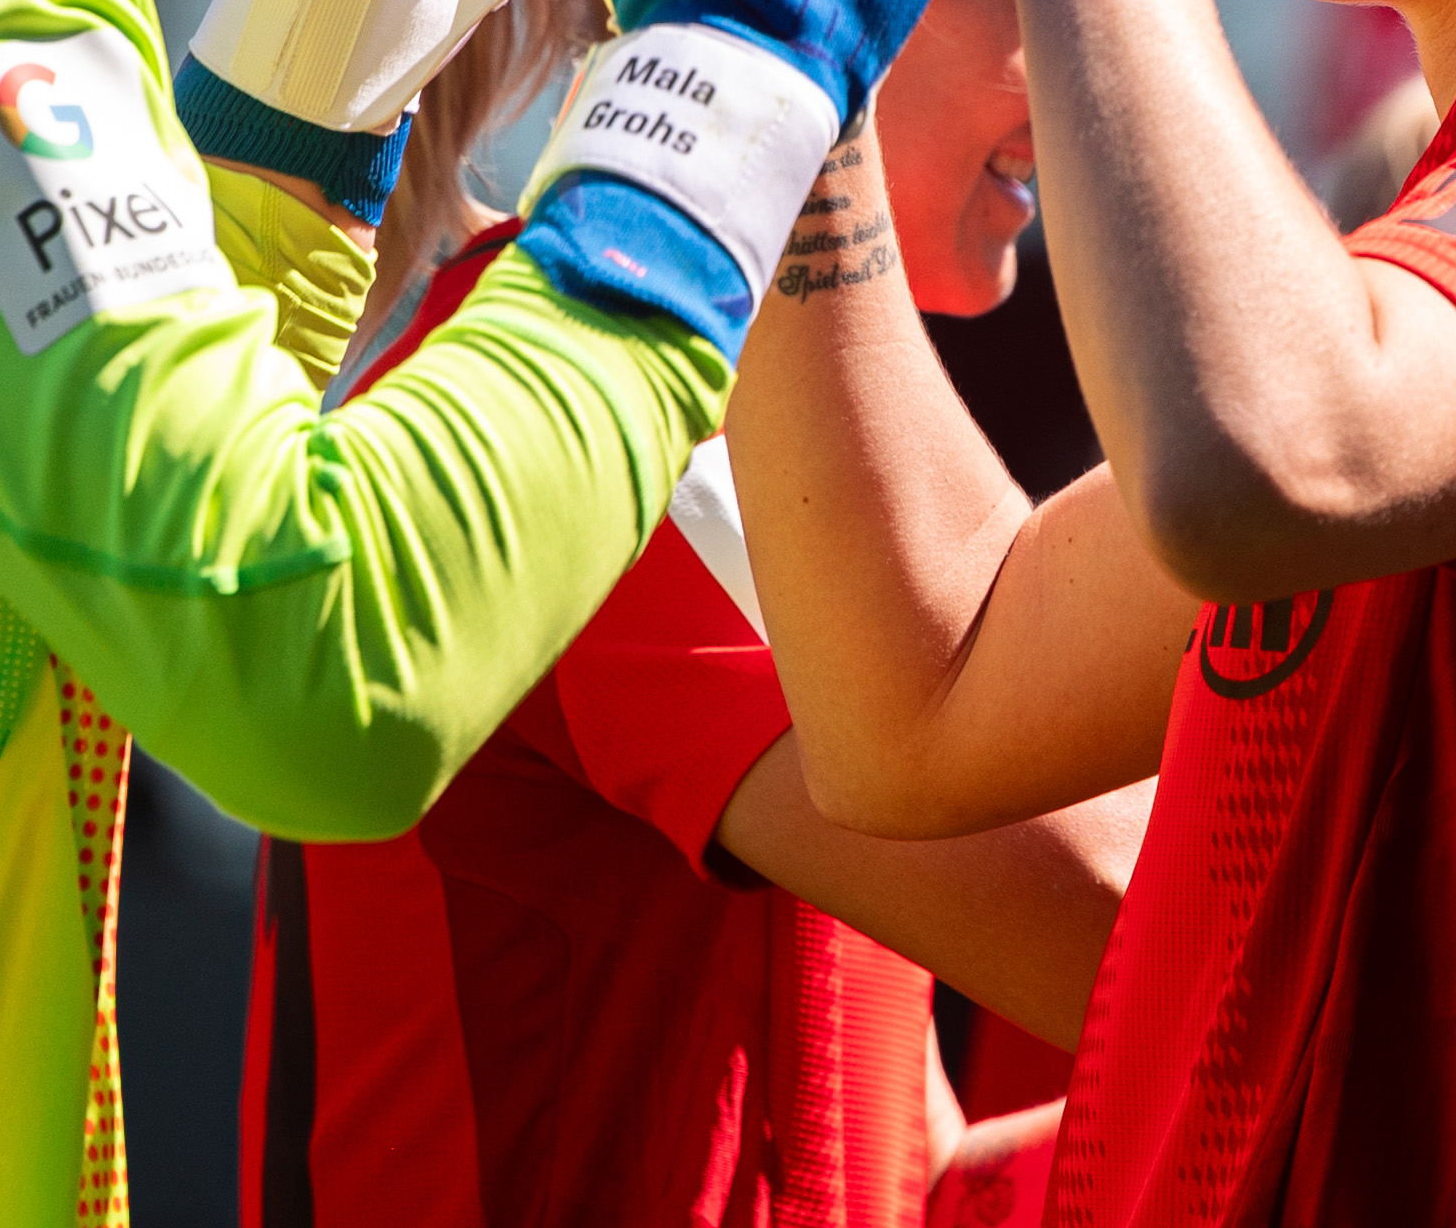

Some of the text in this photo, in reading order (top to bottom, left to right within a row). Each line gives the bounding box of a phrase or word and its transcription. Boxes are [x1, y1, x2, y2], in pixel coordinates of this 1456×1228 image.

[616, 56, 716, 107] Mala
[583, 100, 698, 155] Grohs
[15, 183, 182, 272] Pixel
[777, 262, 839, 304] Spiel
